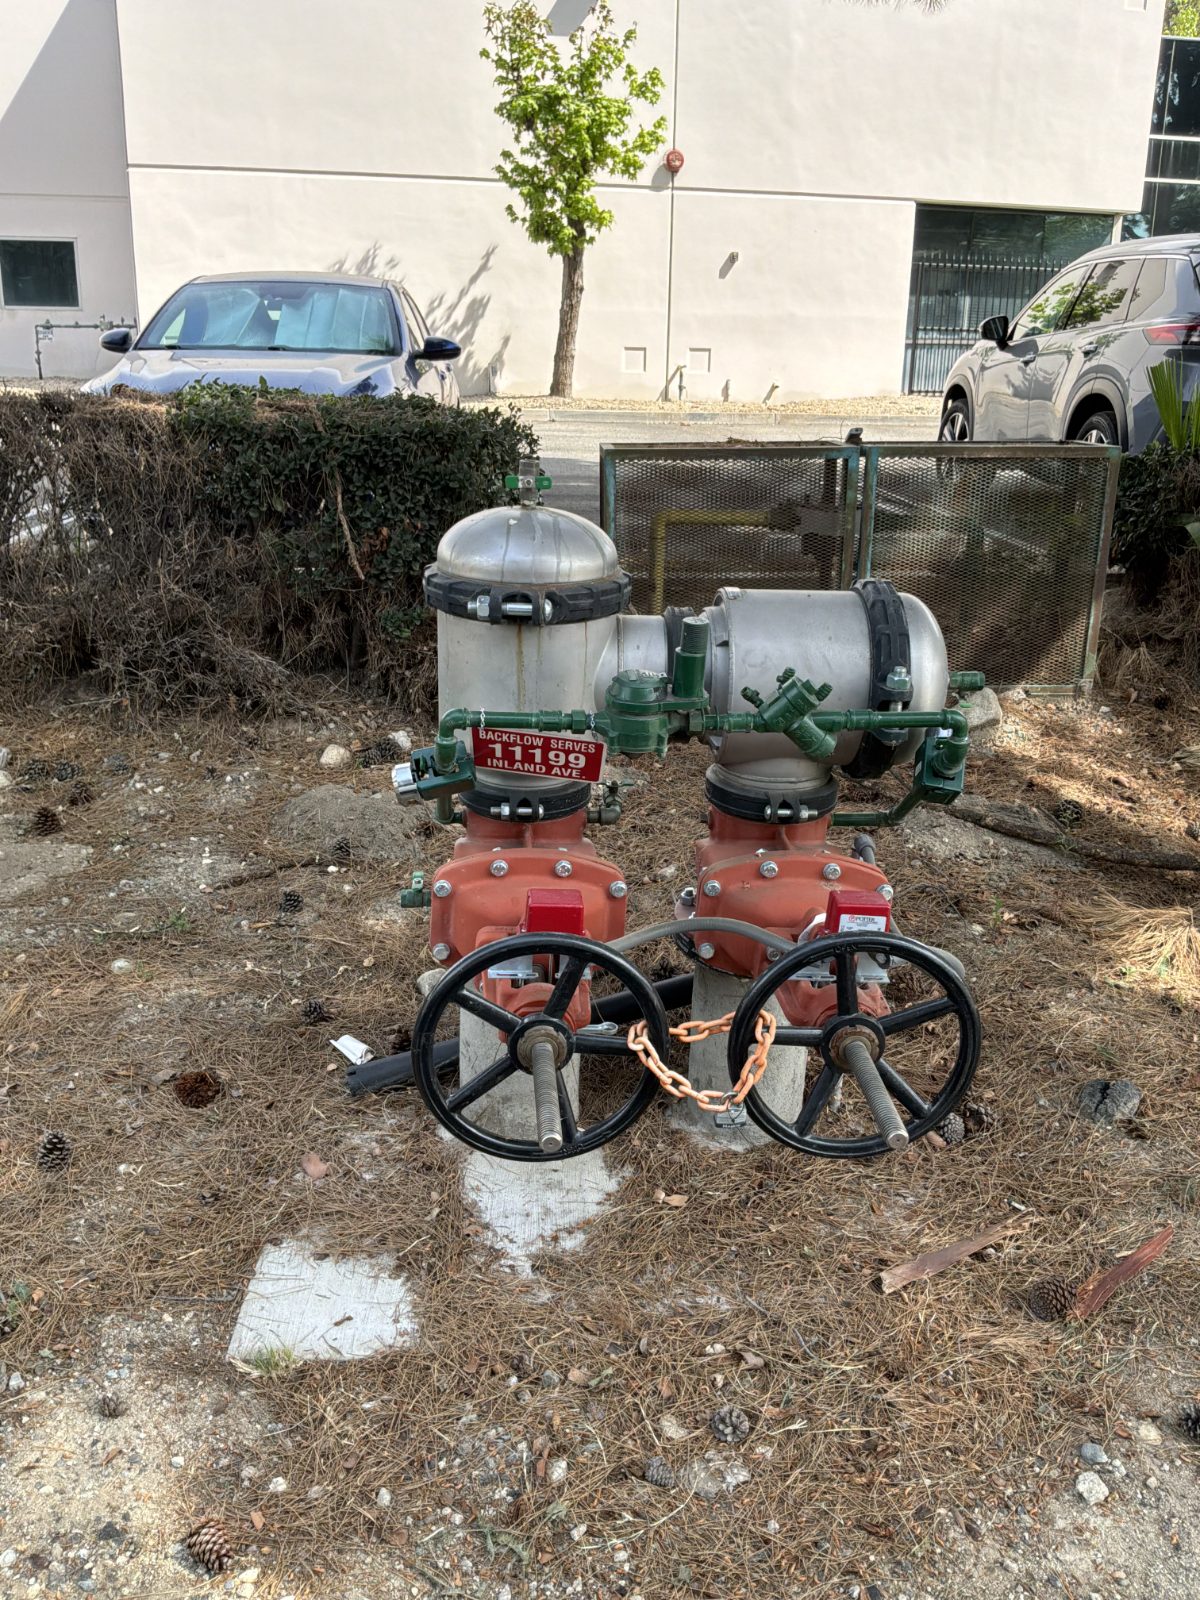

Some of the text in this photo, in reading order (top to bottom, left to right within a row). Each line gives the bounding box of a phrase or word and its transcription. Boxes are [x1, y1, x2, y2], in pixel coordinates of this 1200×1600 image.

[479, 731, 596, 753] BACKFLOW SERVES
[488, 743, 586, 769] 11199
[487, 758, 586, 779] INLAND AVE.
